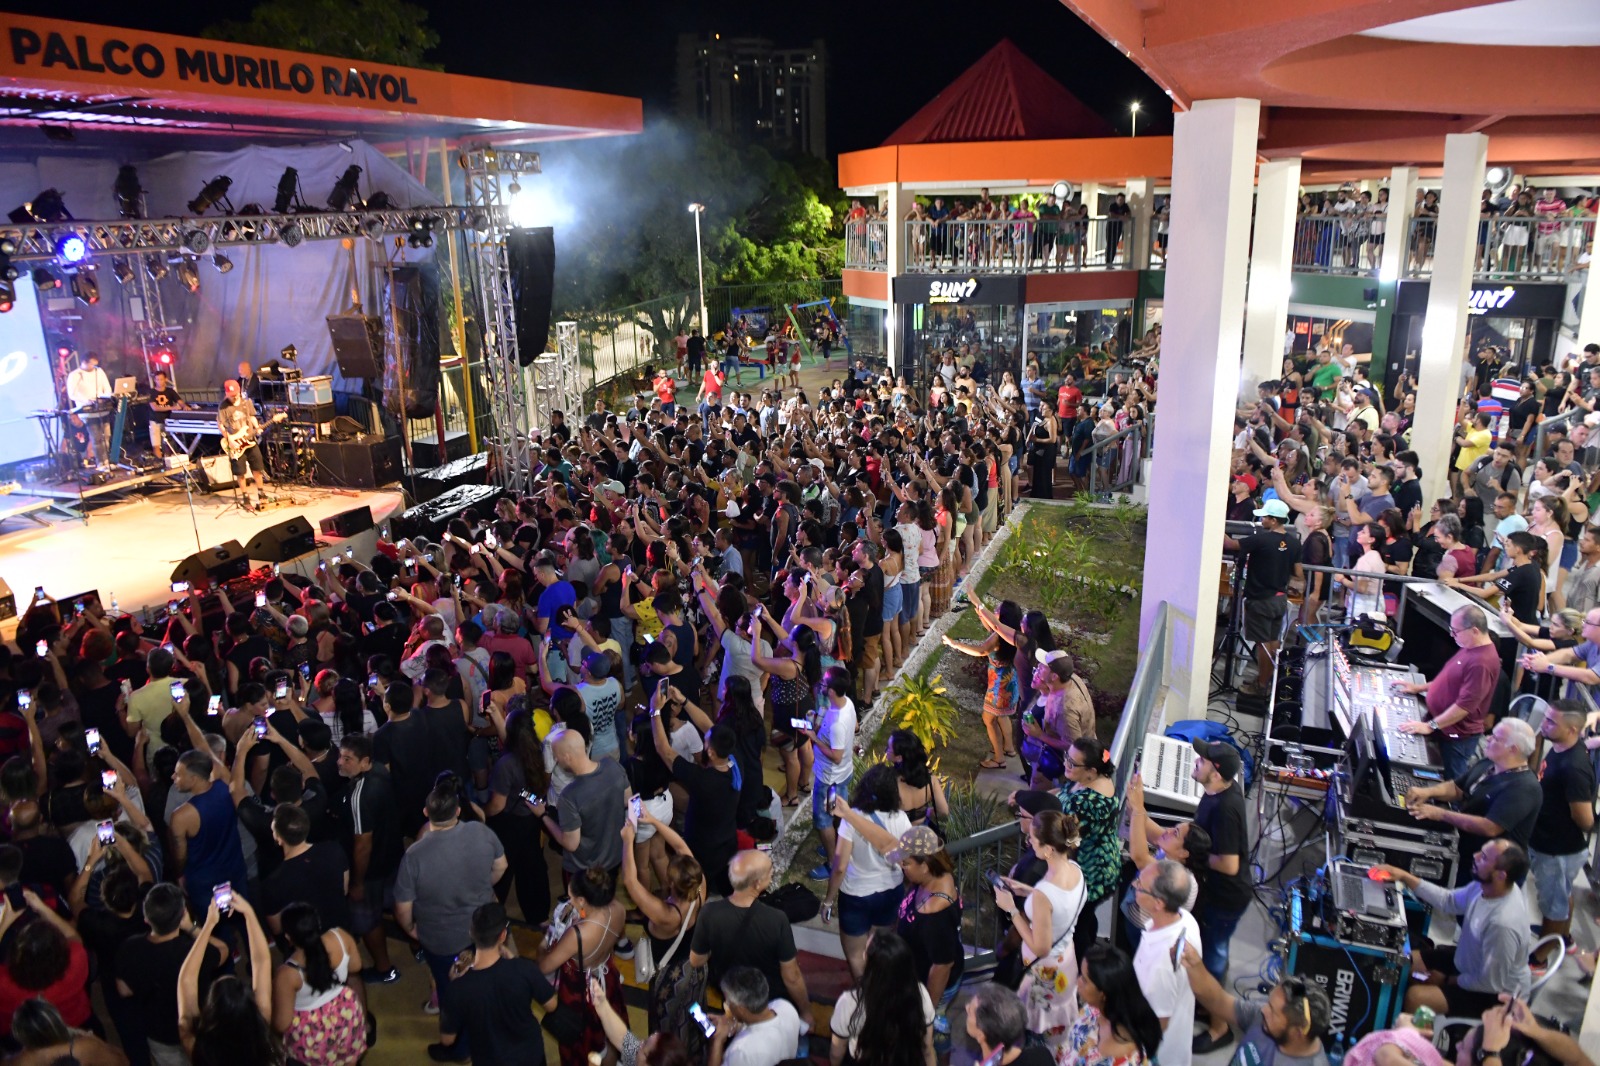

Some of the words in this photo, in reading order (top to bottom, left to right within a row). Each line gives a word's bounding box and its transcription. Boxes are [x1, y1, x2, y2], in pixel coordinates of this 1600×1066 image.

[10, 28, 165, 78] PALCO
[176, 48, 315, 95] MURILO
[322, 67, 417, 104] RAYOL
[929, 278, 977, 297] SUN7
[1467, 286, 1515, 308] UN7
[1329, 969, 1354, 1035] BRIWAX
